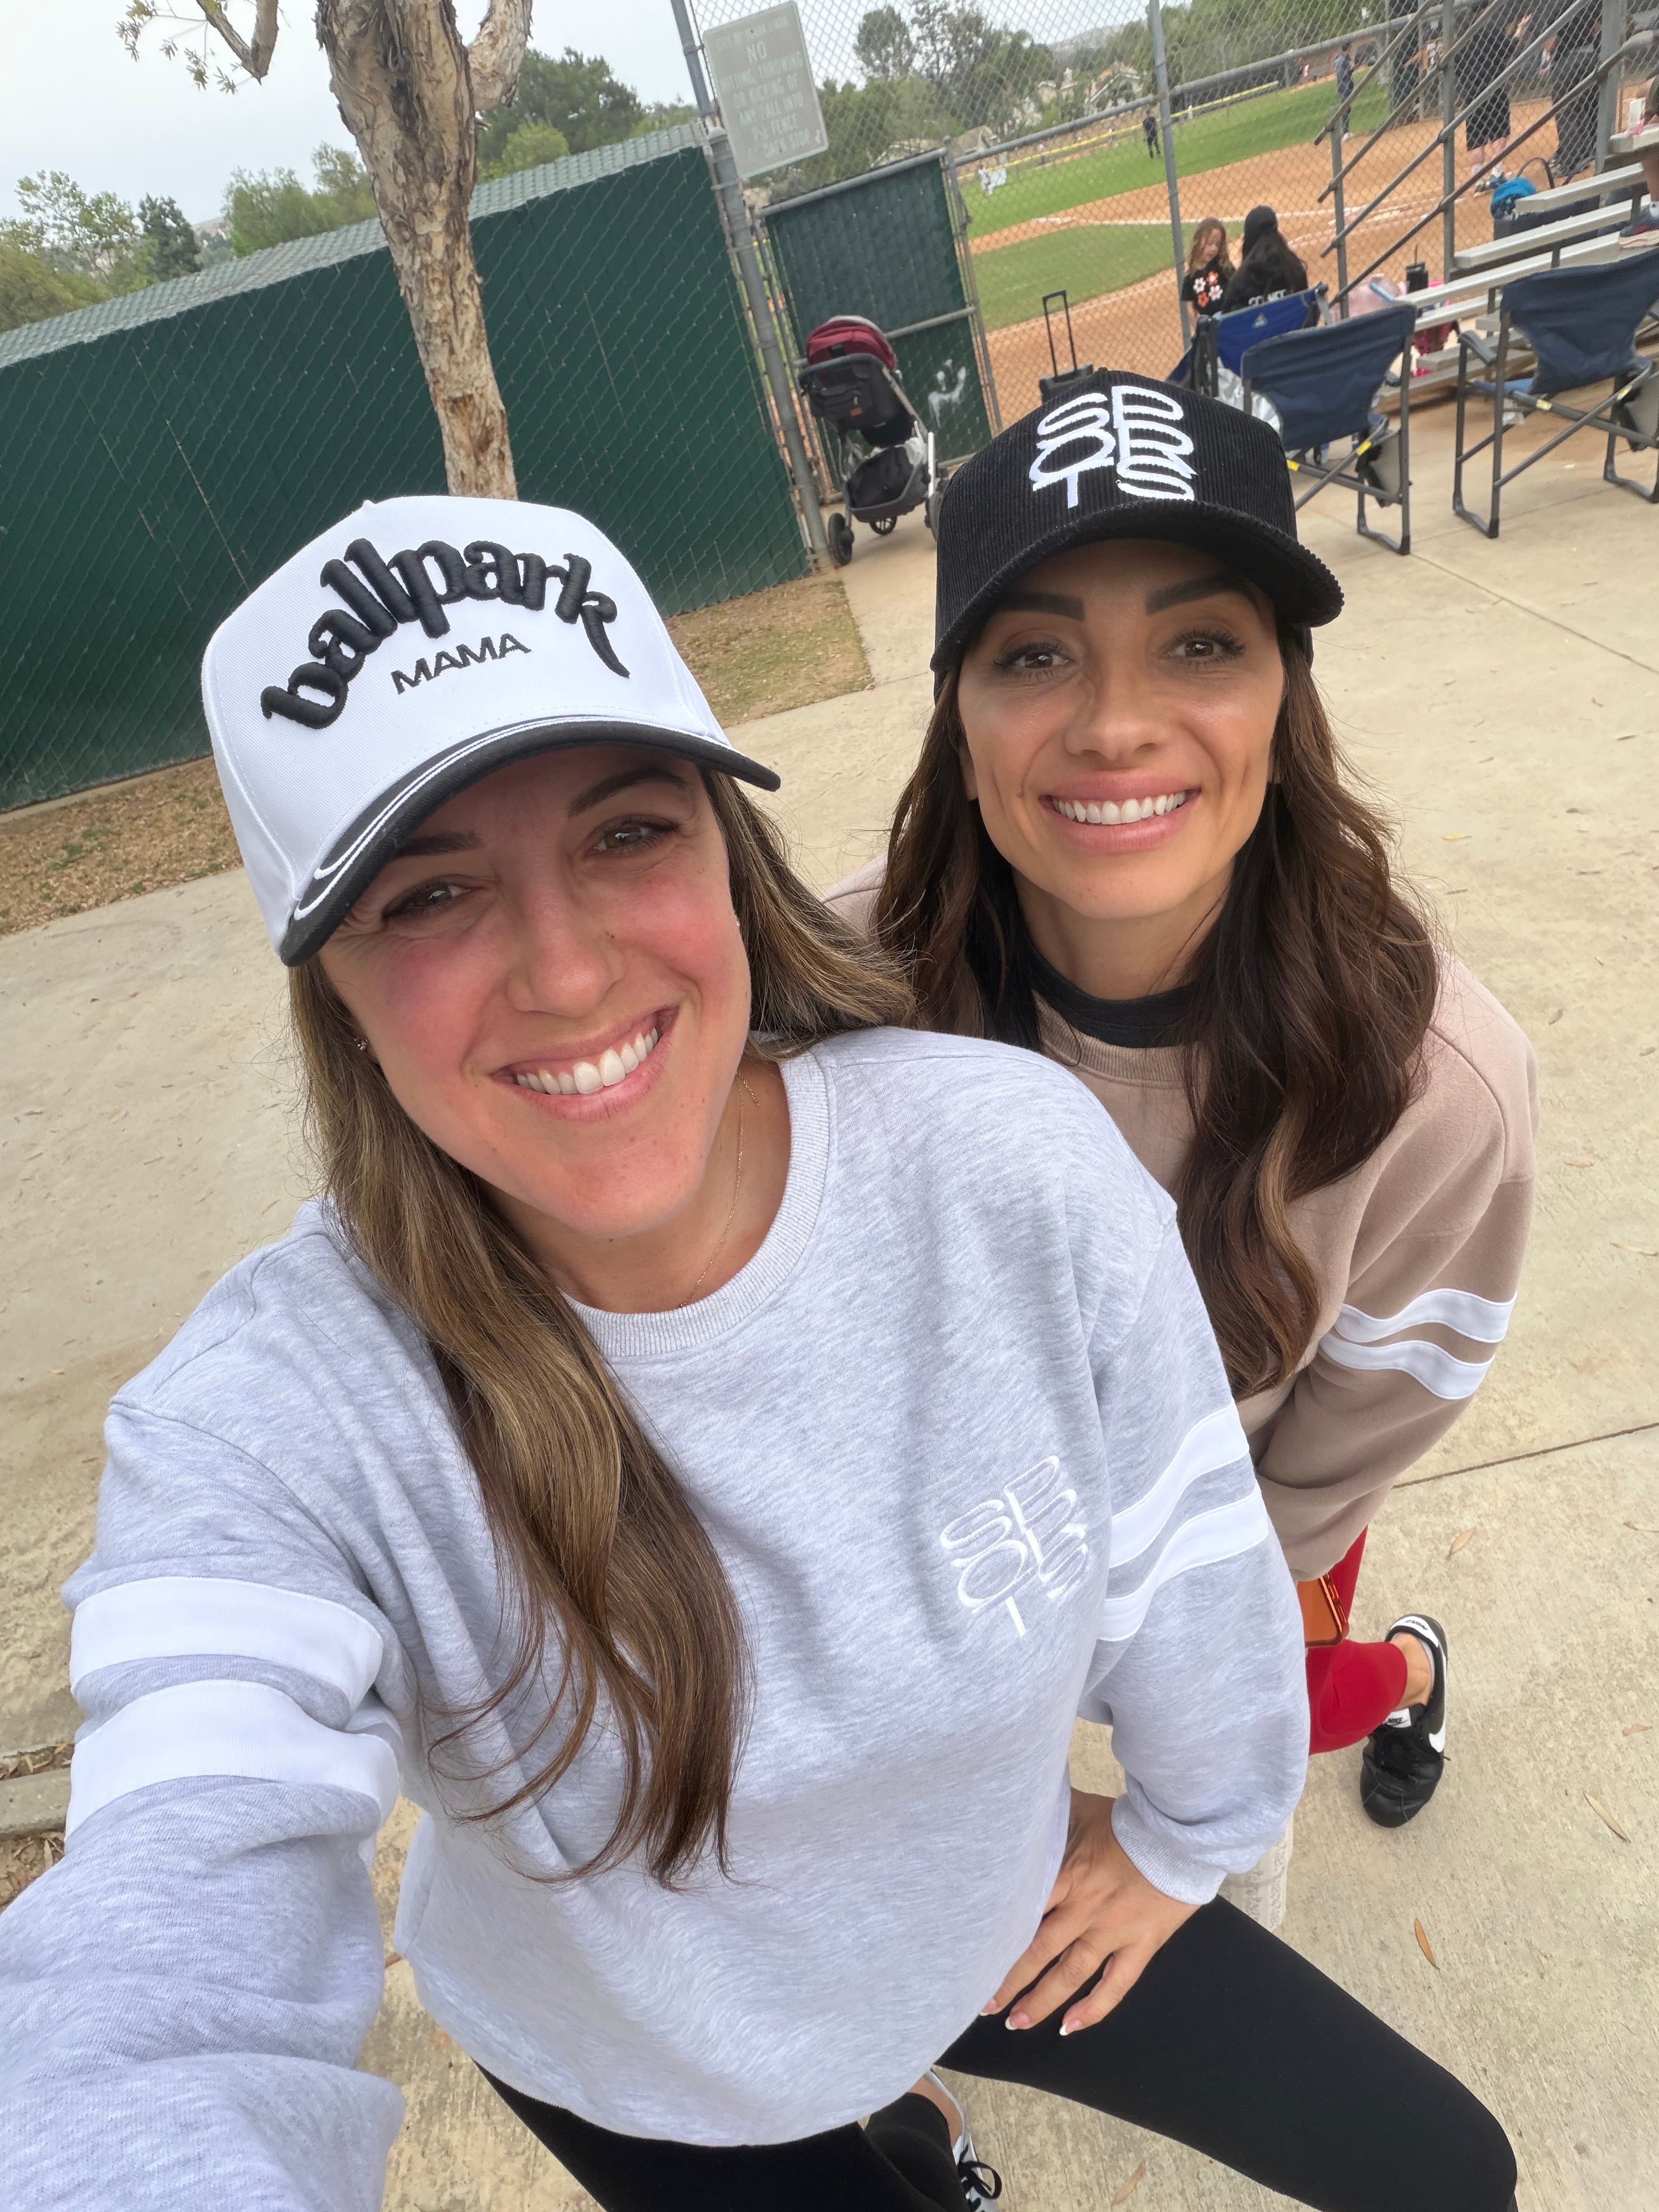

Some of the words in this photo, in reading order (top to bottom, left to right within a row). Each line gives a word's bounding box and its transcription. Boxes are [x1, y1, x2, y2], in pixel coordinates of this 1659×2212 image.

[745, 39, 769, 64] NO
[260, 538, 630, 729] ballpark
[390, 633, 531, 694] MAMA
